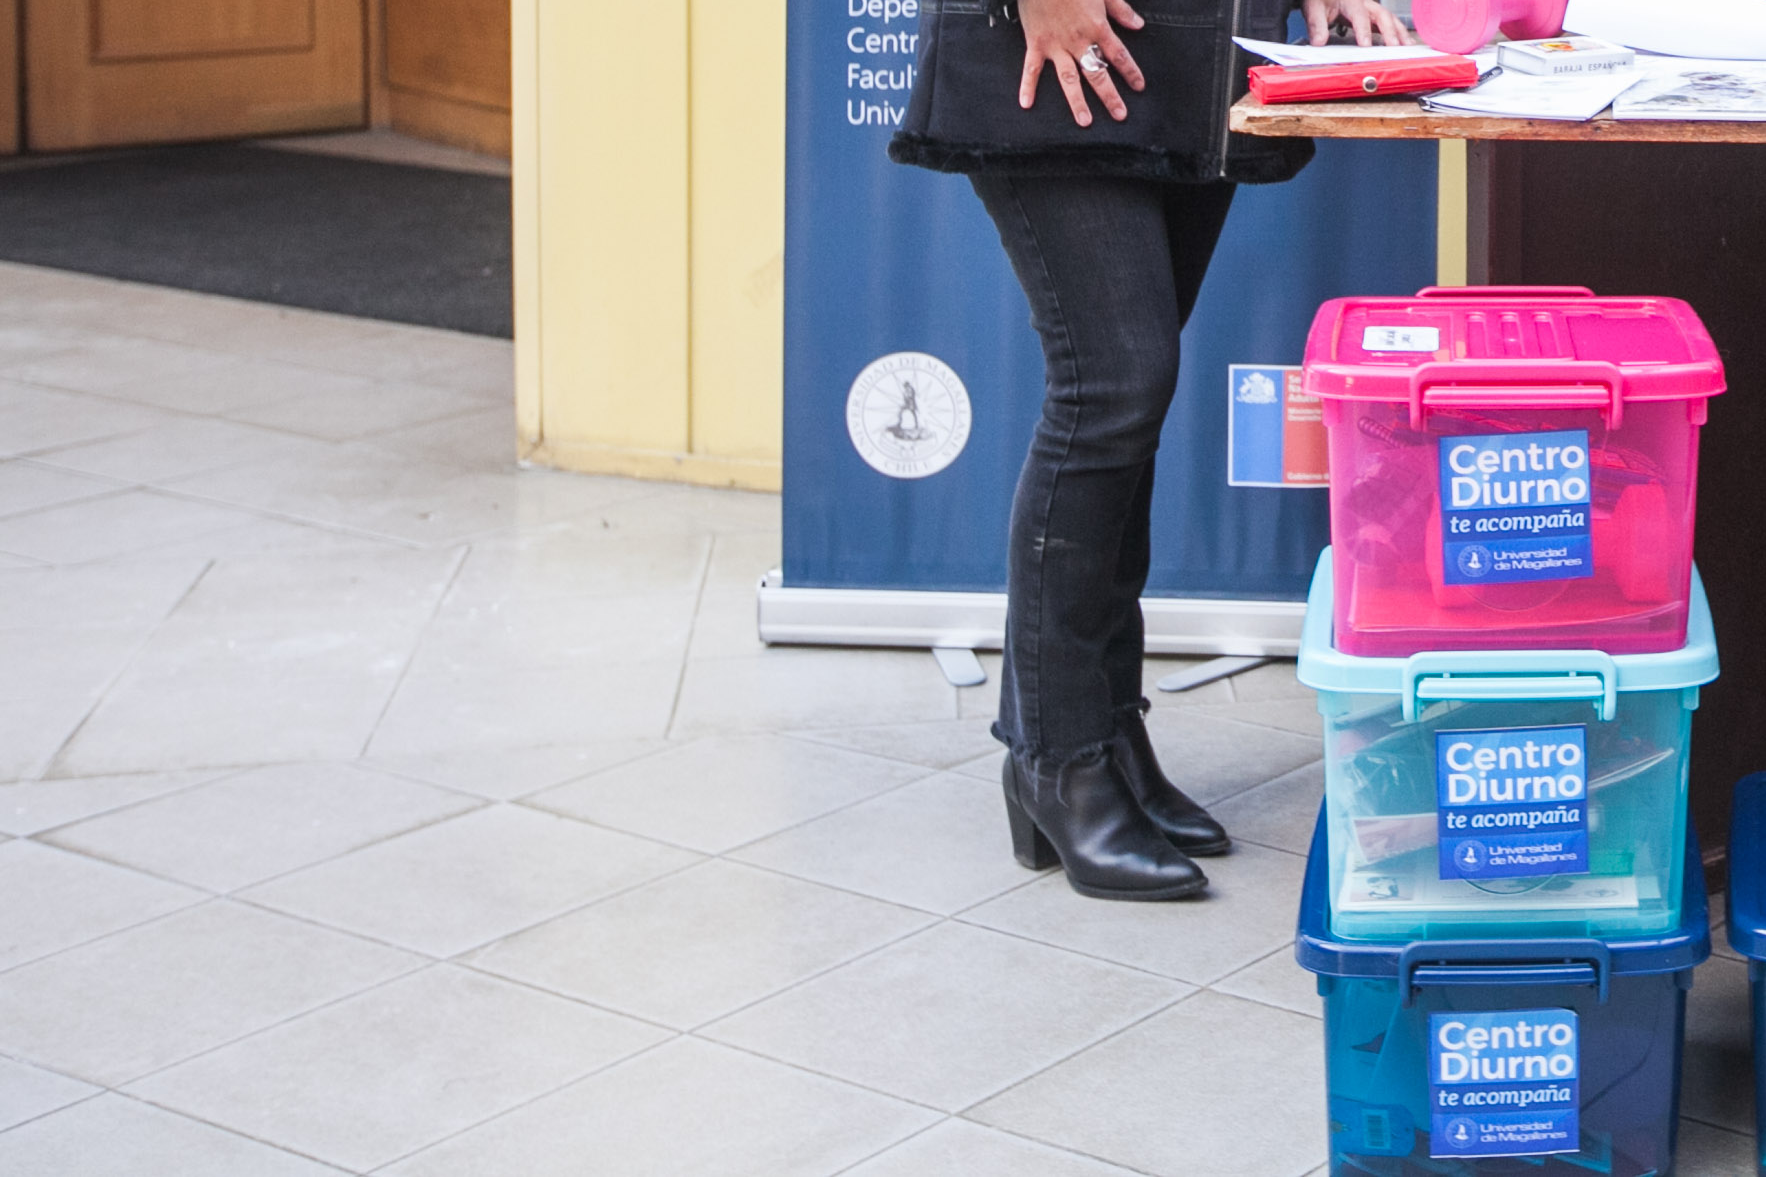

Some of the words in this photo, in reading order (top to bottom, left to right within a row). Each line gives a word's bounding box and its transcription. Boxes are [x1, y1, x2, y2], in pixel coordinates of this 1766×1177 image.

[1449, 441, 1585, 475] Centro
[1451, 472, 1587, 508] Diurno
[1450, 515, 1473, 534] te
[1475, 510, 1585, 534] acompaña
[1445, 740, 1582, 773] Centro
[1447, 770, 1583, 803] Diurno
[1447, 812, 1467, 829] te
[1471, 806, 1581, 829] acompaña
[1439, 1020, 1573, 1052] Centro
[1440, 1050, 1574, 1083] Diurno
[1439, 1089, 1458, 1106] te
[1463, 1085, 1571, 1108] acompaña
